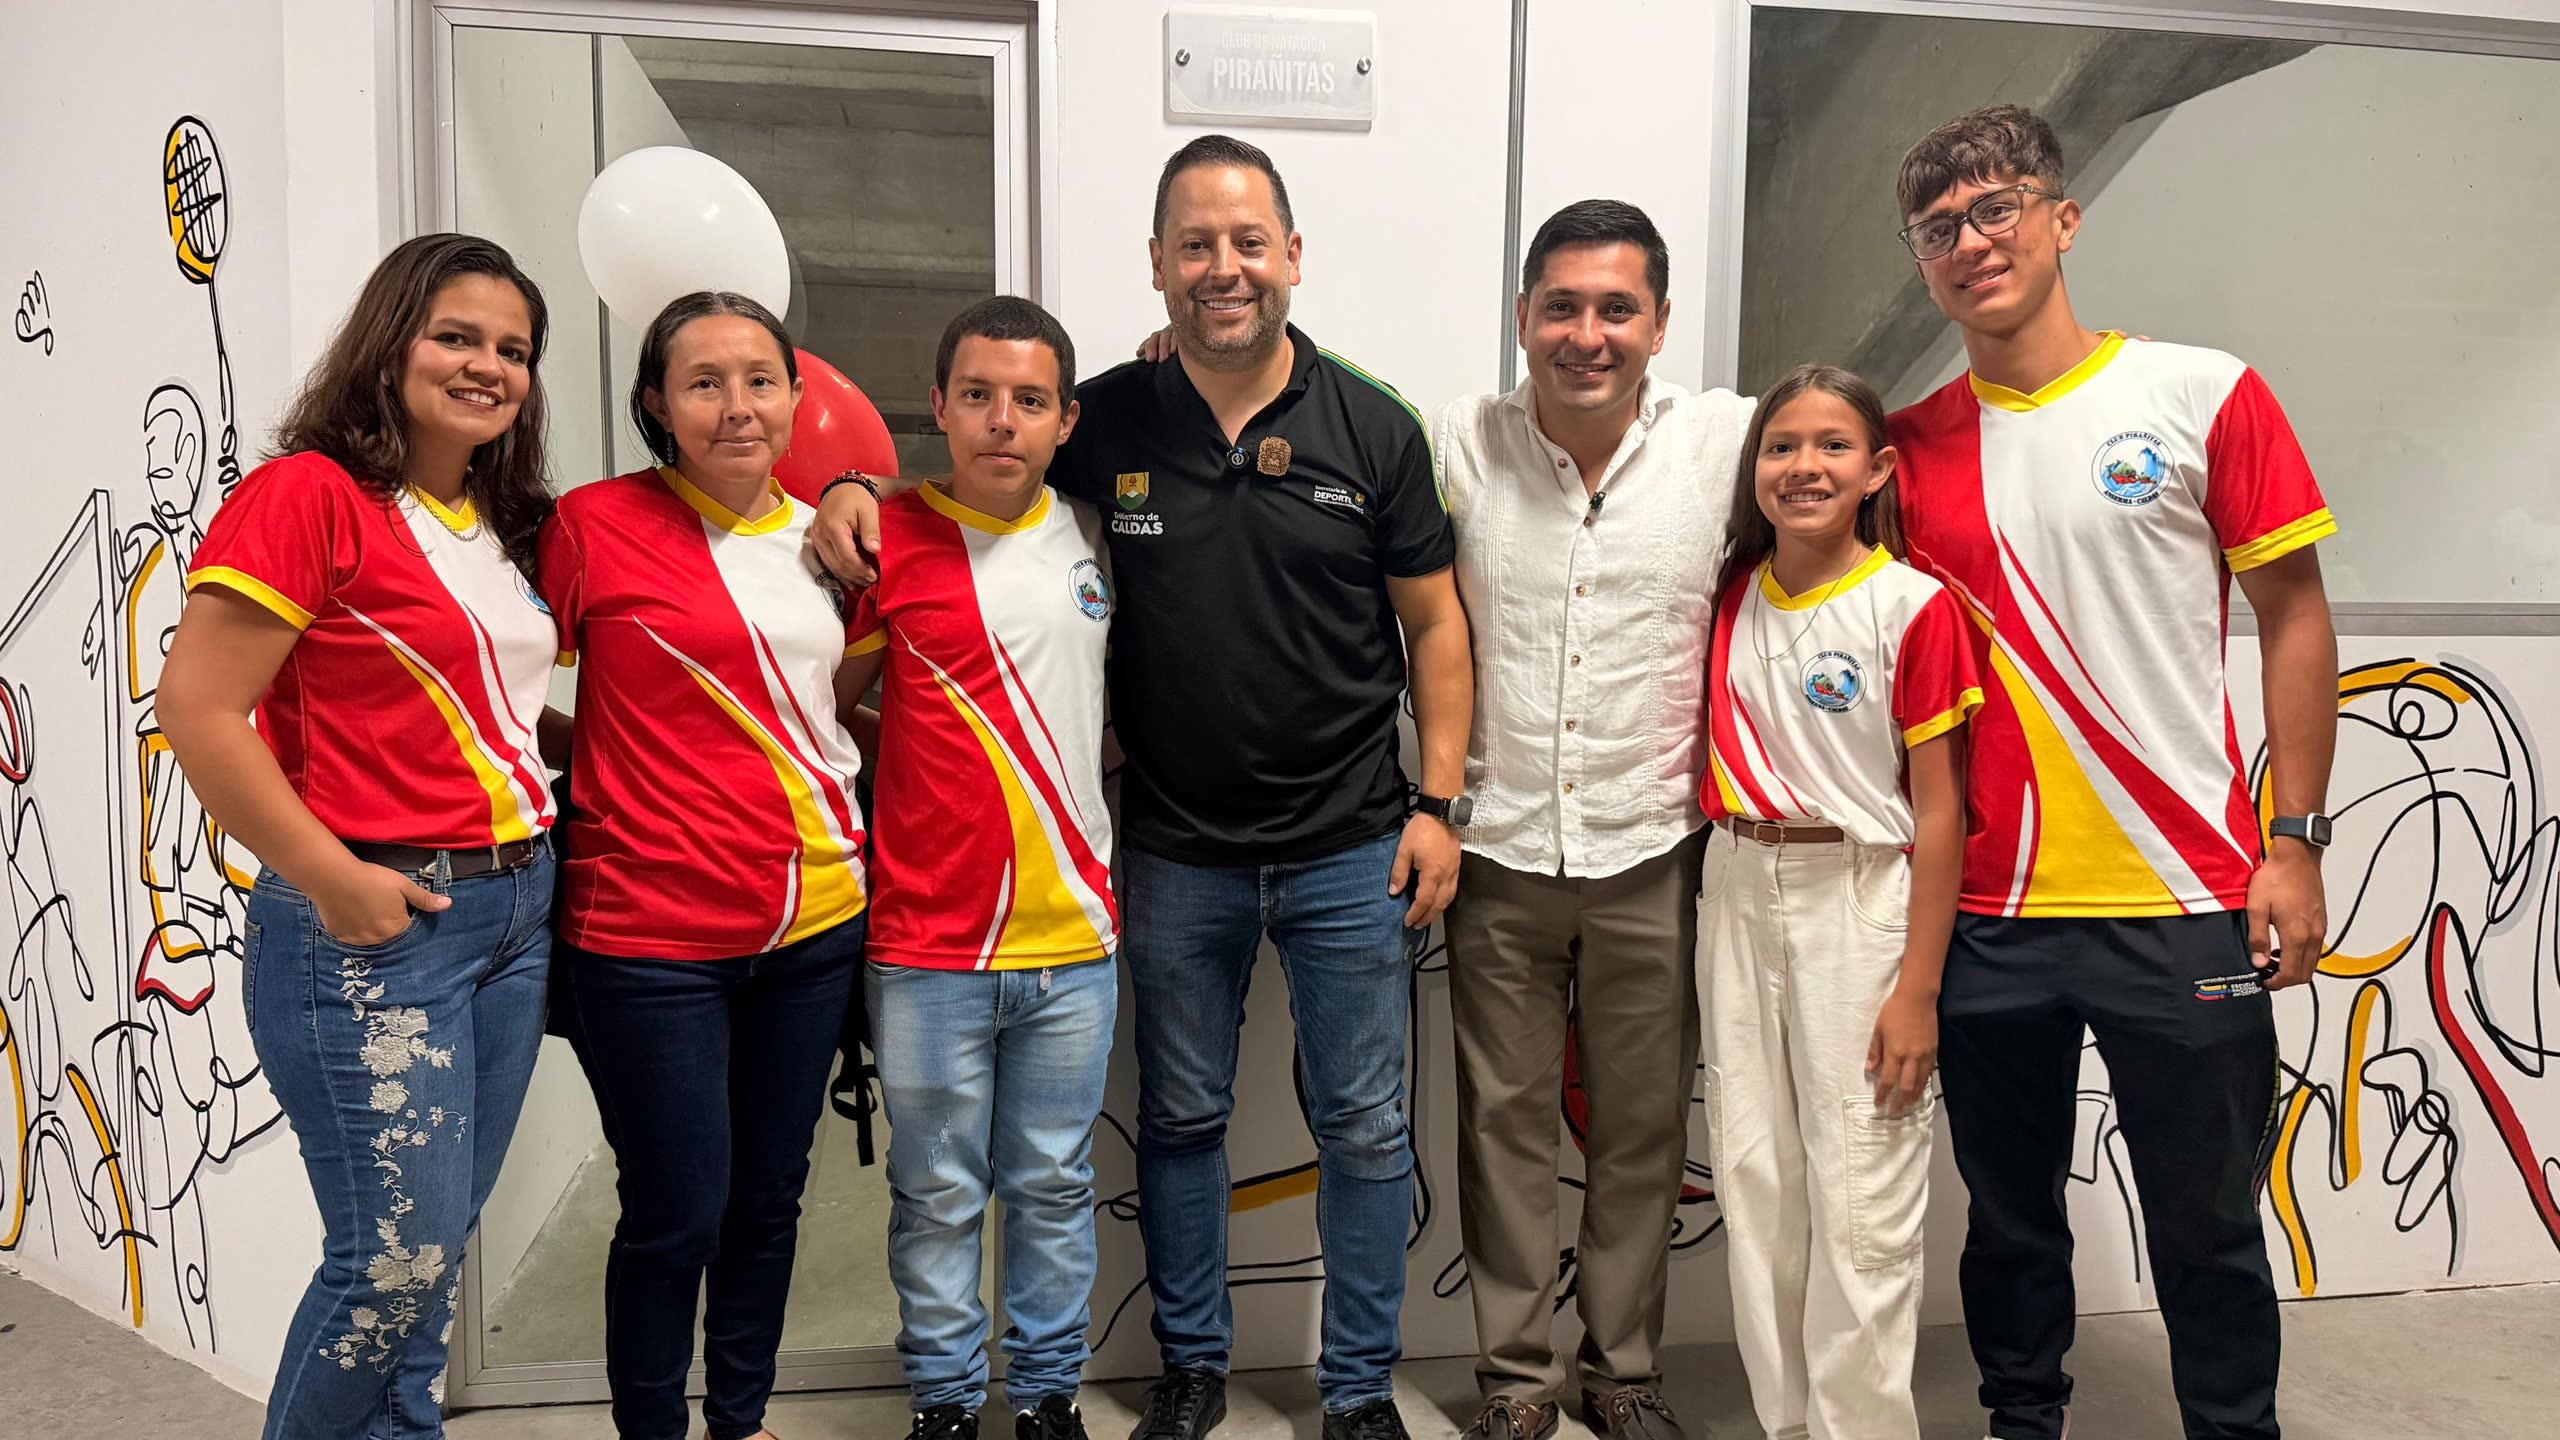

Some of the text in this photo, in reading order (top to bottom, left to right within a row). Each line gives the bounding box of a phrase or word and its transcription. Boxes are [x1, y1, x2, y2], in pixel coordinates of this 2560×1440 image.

[1213, 53, 1336, 94] PIRAÑITAS
[1146, 512, 1160, 521] de
[1111, 520, 1164, 535] CALDAS
